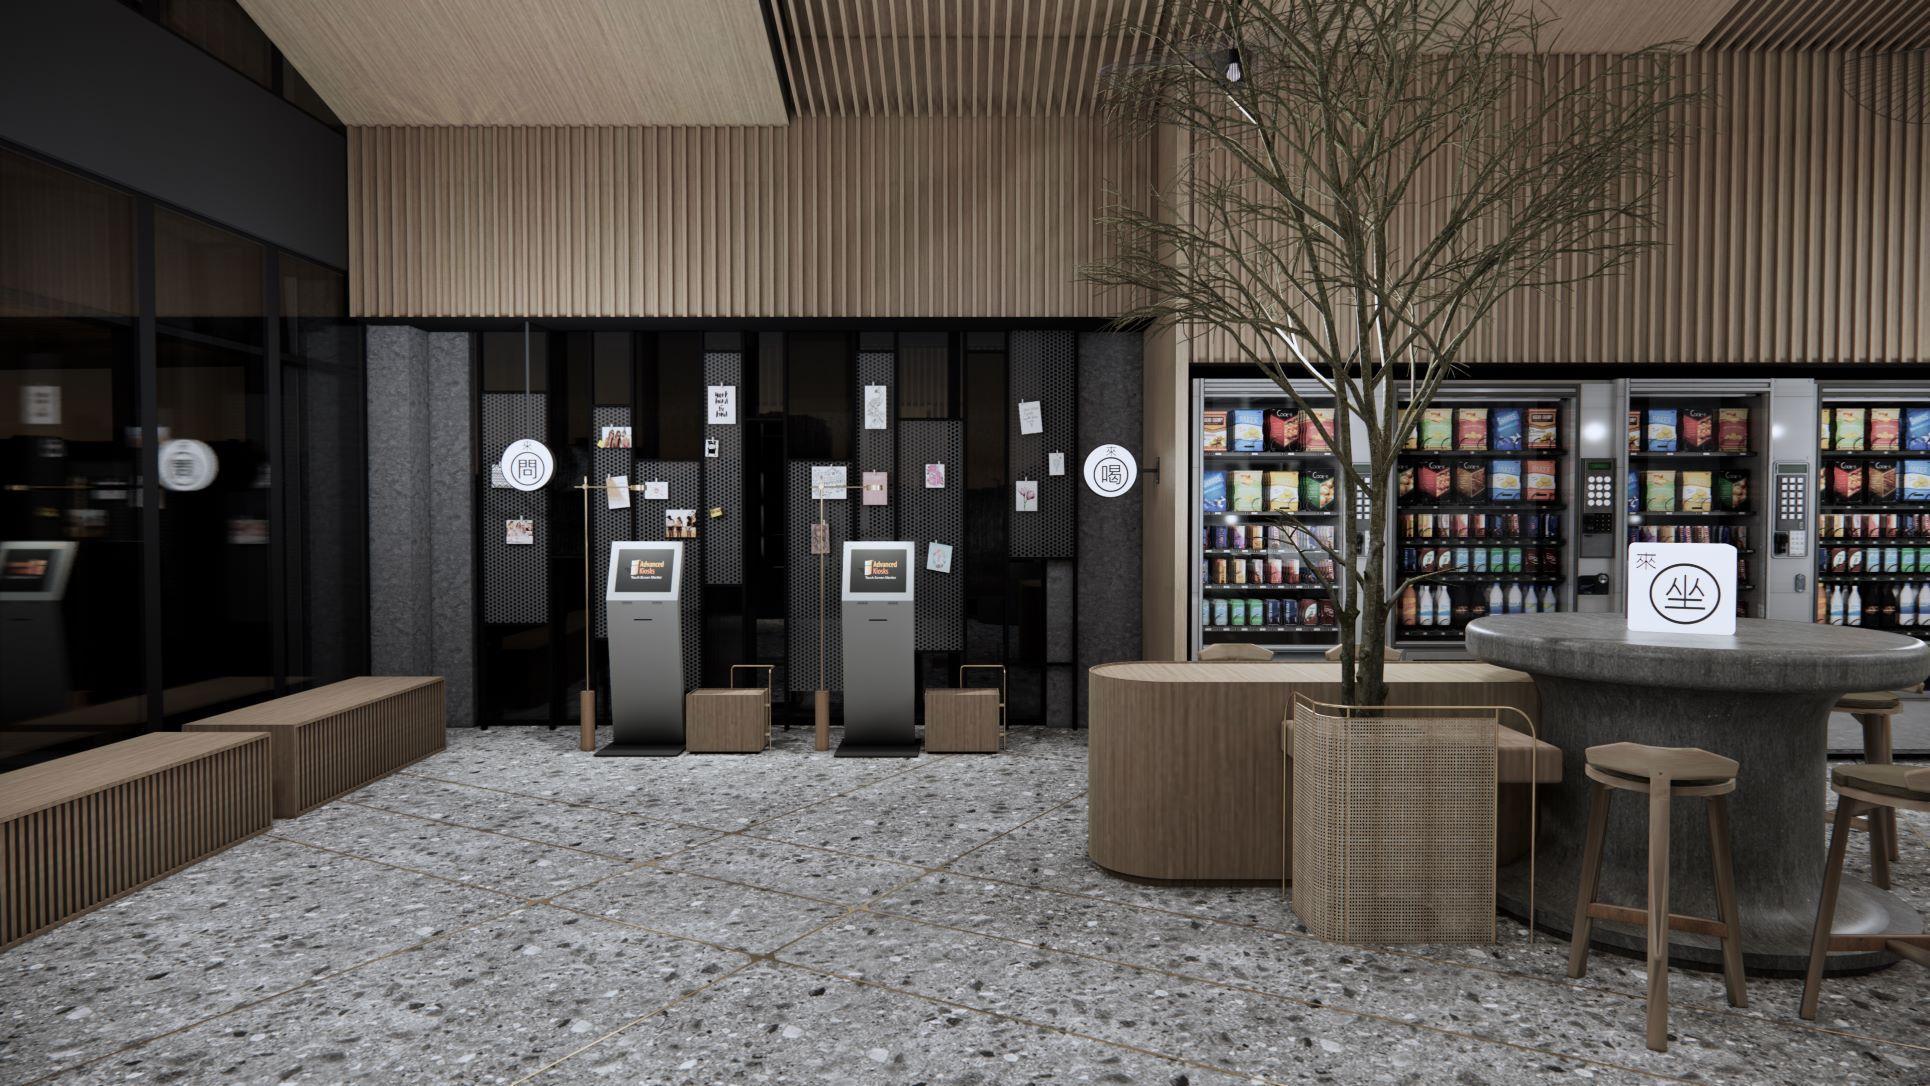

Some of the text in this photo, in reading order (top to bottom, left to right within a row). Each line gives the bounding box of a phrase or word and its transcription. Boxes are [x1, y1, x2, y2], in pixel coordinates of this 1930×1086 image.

[518, 459, 537, 479] 問
[1101, 464, 1121, 485] 喝
[639, 560, 665, 568] Advanced
[873, 560, 898, 568] Advanced
[1636, 552, 1657, 570] 來
[1664, 574, 1706, 611] 坐
